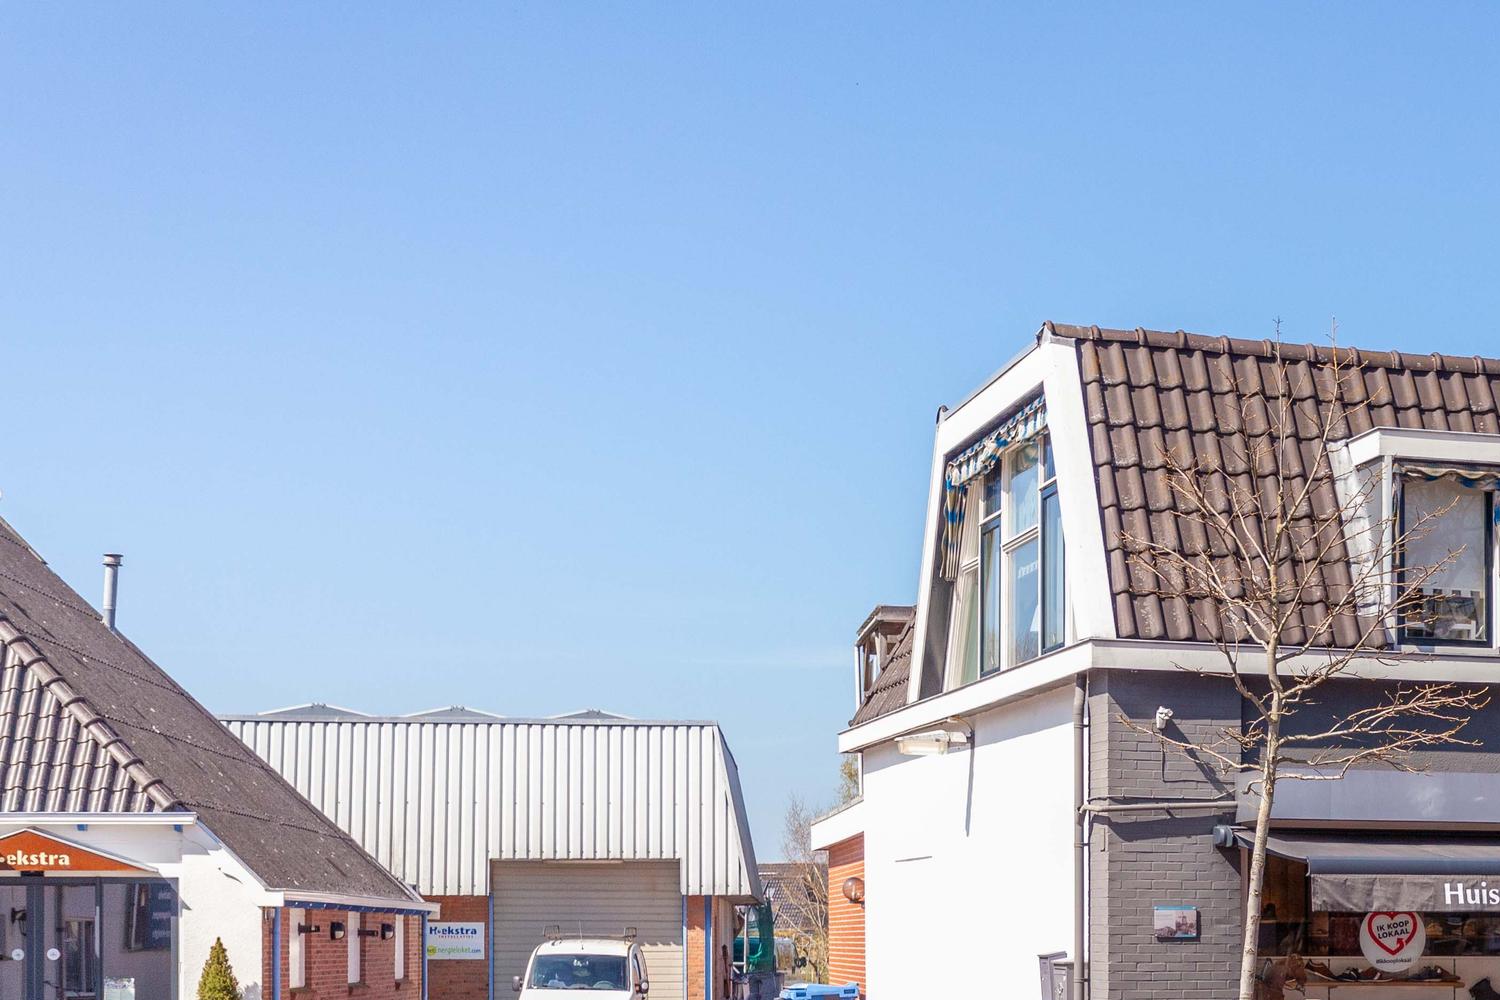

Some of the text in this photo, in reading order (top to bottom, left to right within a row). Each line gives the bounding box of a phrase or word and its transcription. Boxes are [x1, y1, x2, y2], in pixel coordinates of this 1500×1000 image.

[1376, 920, 1410, 932] IK KOOP
[1377, 928, 1410, 939] LOKAAL
